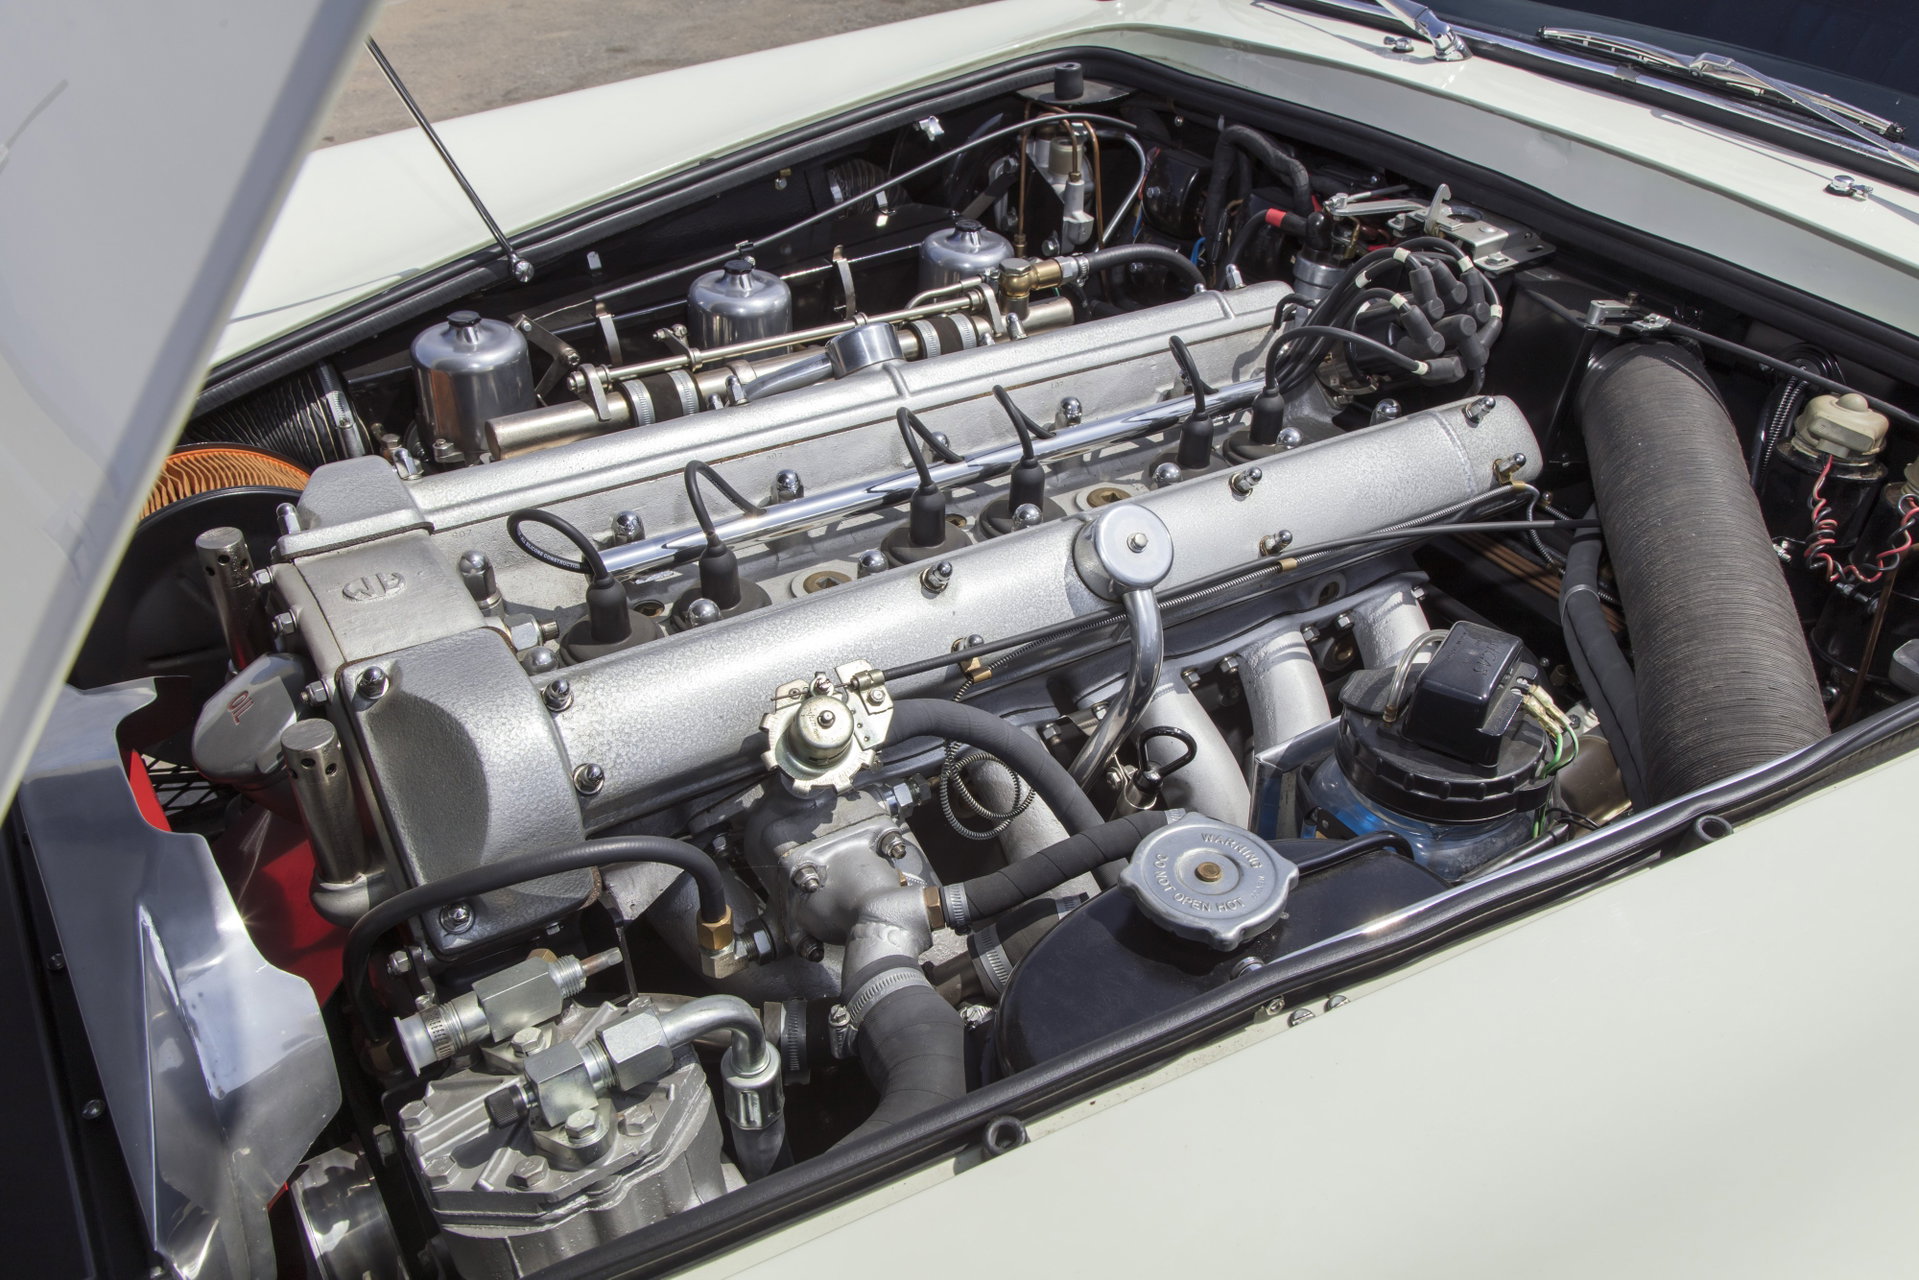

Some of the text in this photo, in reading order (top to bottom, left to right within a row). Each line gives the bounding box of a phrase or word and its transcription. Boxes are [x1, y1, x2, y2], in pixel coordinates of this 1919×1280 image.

[525, 542, 544, 557] SILICONE
[543, 553, 581, 569] CONSTRUCTION
[1472, 640, 1500, 676] UCAS
[227, 690, 255, 726] OIL
[1201, 832, 1263, 869] WARNING
[1154, 853, 1246, 913] DO NOT OPEN HOT
